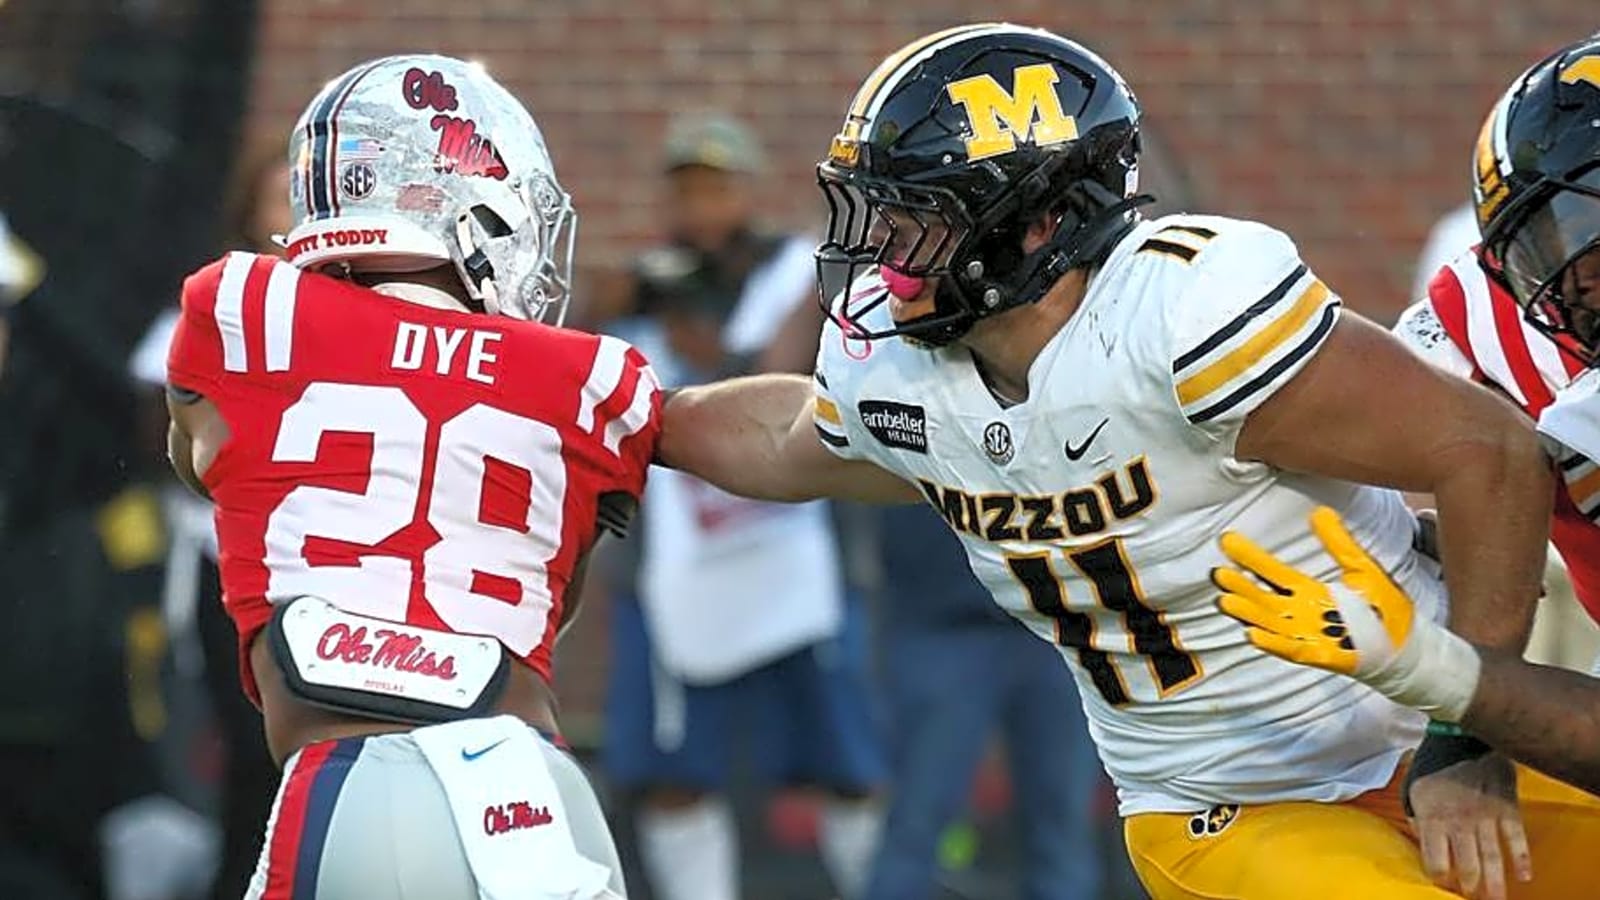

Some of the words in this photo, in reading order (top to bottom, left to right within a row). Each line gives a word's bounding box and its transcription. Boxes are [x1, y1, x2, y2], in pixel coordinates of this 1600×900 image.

[402, 67, 459, 112] Ole
[946, 63, 1079, 163] M
[430, 114, 510, 181] Miss
[343, 163, 374, 197] SEC
[322, 229, 388, 247] TODDY
[391, 322, 502, 385] DYE
[862, 409, 924, 434] ambetter
[887, 429, 925, 447] HEALTH
[985, 422, 1011, 454] SEC
[263, 381, 568, 658] 28
[916, 454, 1158, 542] MIZZOU
[1003, 535, 1203, 707] 11
[316, 622, 374, 664] Ole
[372, 628, 458, 680] Miss
[484, 804, 511, 835] Ole
[507, 800, 553, 830] Miss
